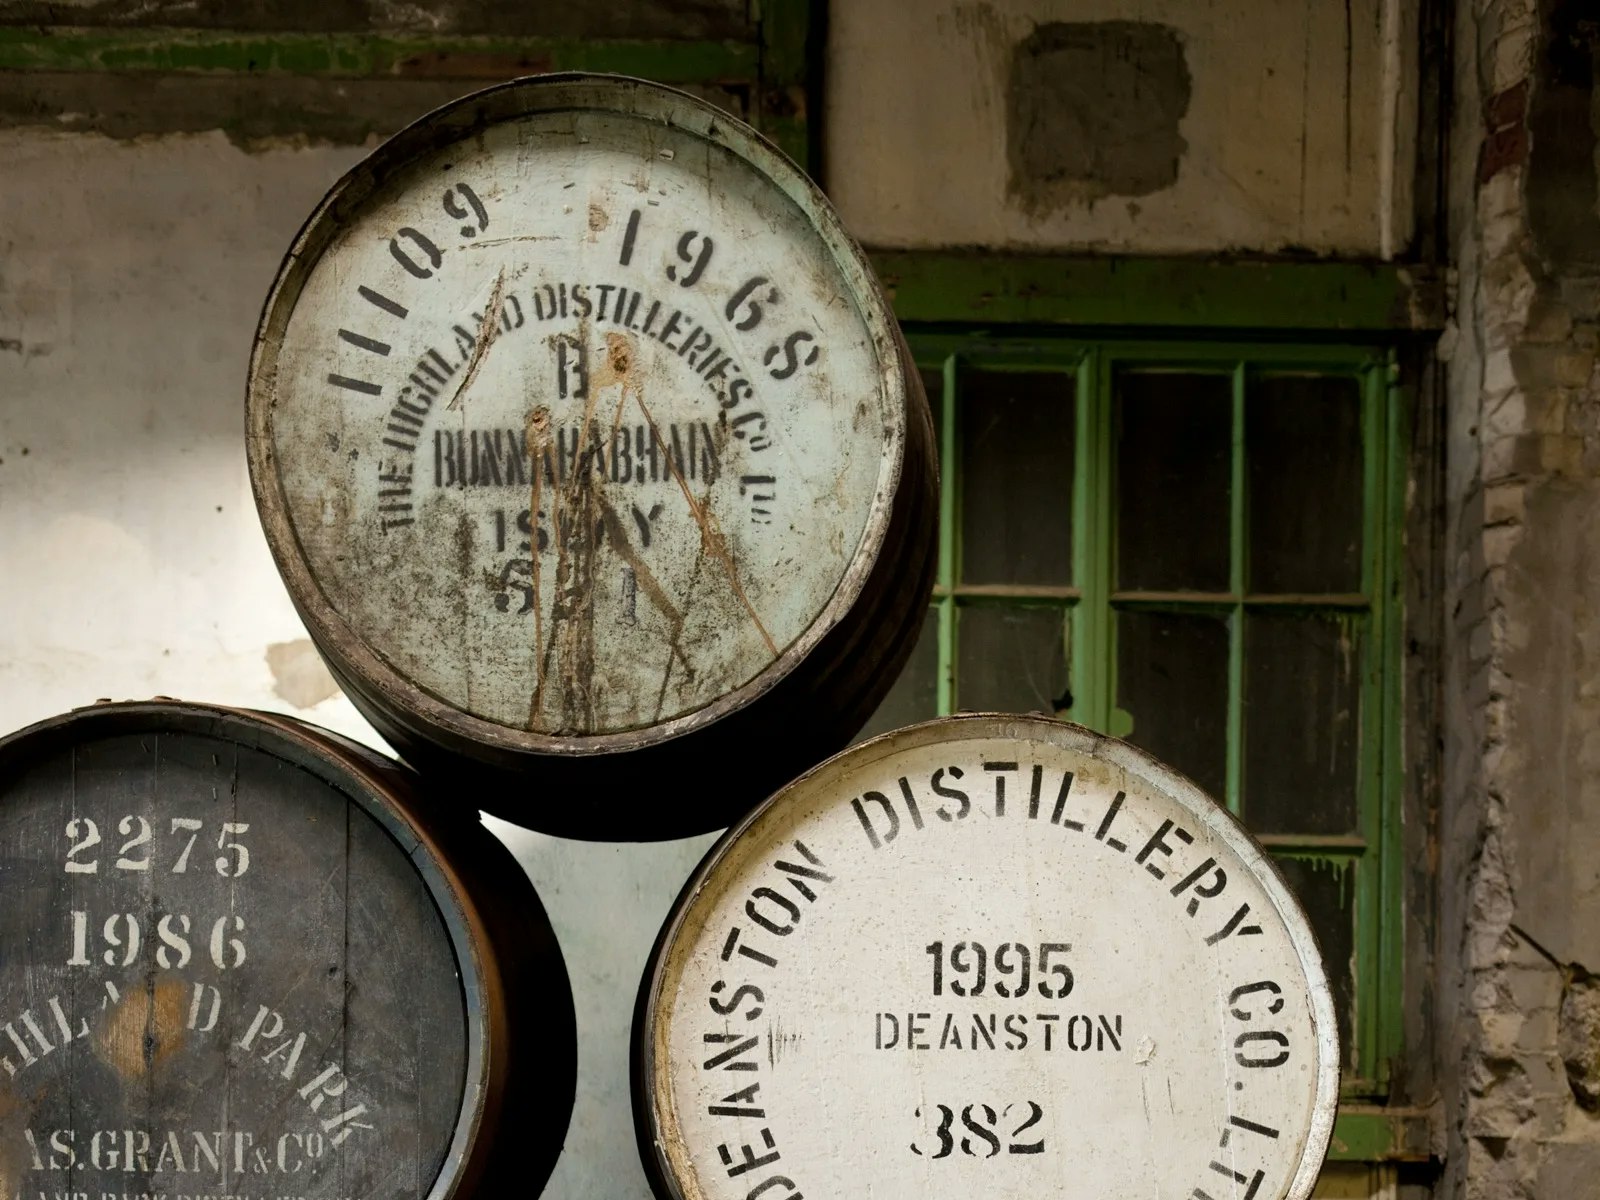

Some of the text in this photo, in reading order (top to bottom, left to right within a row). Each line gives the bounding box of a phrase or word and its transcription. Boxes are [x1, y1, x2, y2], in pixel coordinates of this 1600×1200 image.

[327, 182, 820, 397] 11109 1968
[377, 460, 415, 536] THE
[533, 282, 755, 410] DISTILLERIES
[64, 815, 250, 878] 2275
[850, 761, 1263, 948] DISTILLERY
[67, 911, 247, 969] 1986
[926, 941, 1076, 1000] 1995
[875, 1013, 1124, 1053] DEANSTON
[238, 1003, 375, 1150] PARK
[909, 1100, 1047, 1159] 382
